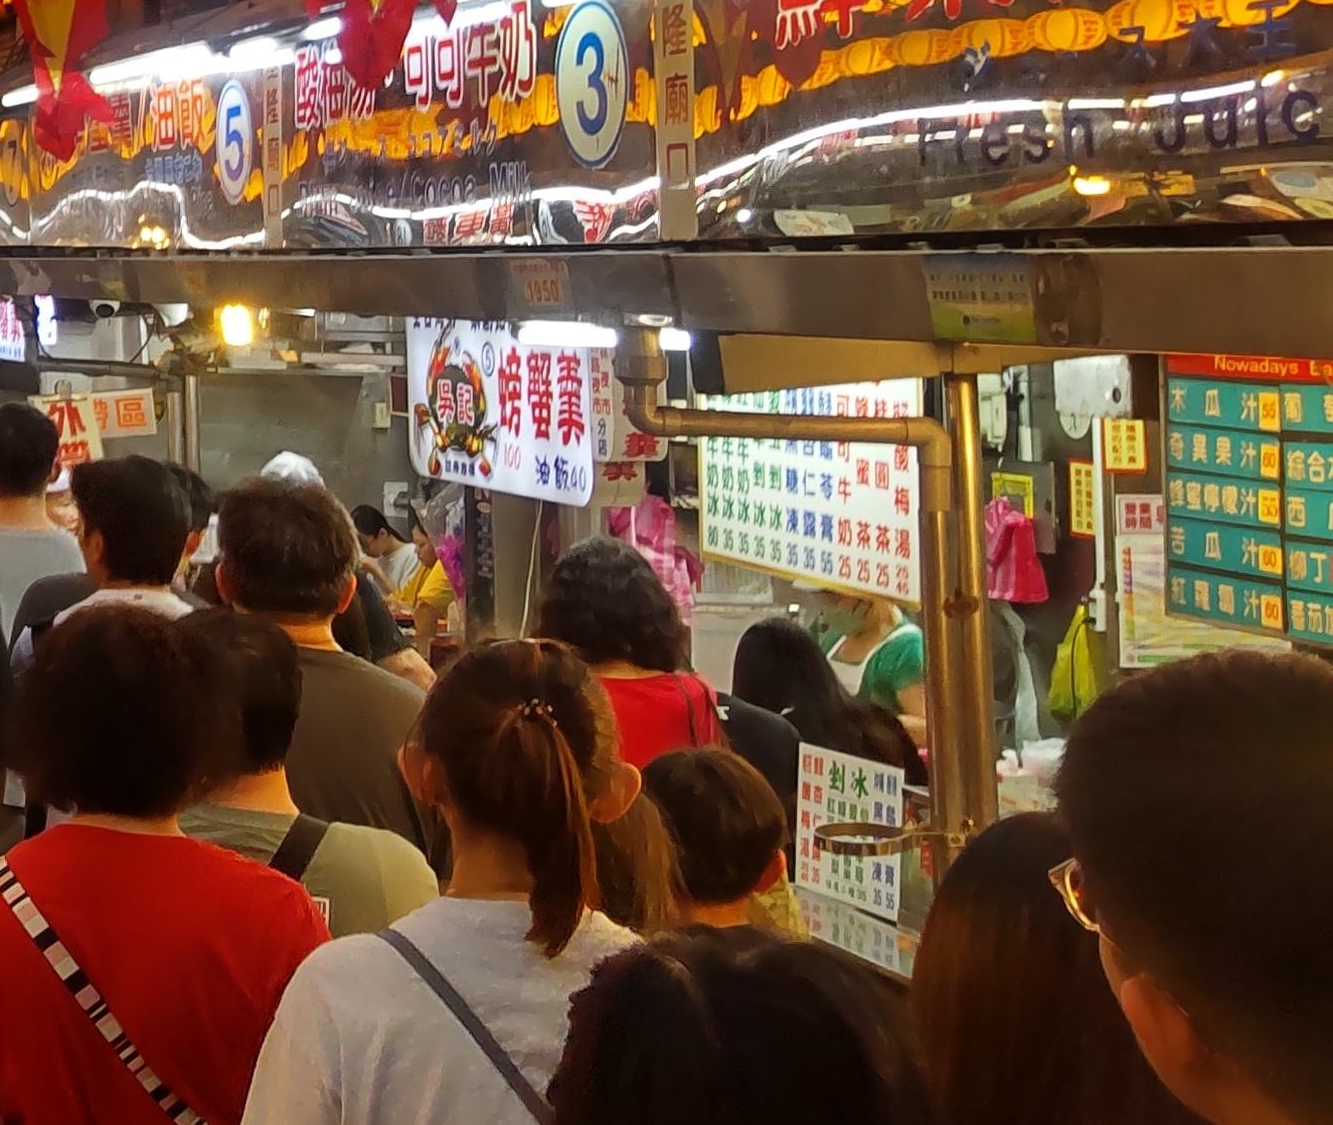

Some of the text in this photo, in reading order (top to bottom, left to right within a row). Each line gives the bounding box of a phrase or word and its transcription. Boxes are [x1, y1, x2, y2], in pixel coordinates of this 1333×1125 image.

[575, 30, 609, 137] 3
[225, 104, 245, 182] 5
[1171, 386, 1259, 423] 木瓜汁
[1170, 432, 1258, 469] 奇異果汁
[1170, 527, 1259, 567] 苦瓜汁
[827, 759, 870, 800] 剉冰
